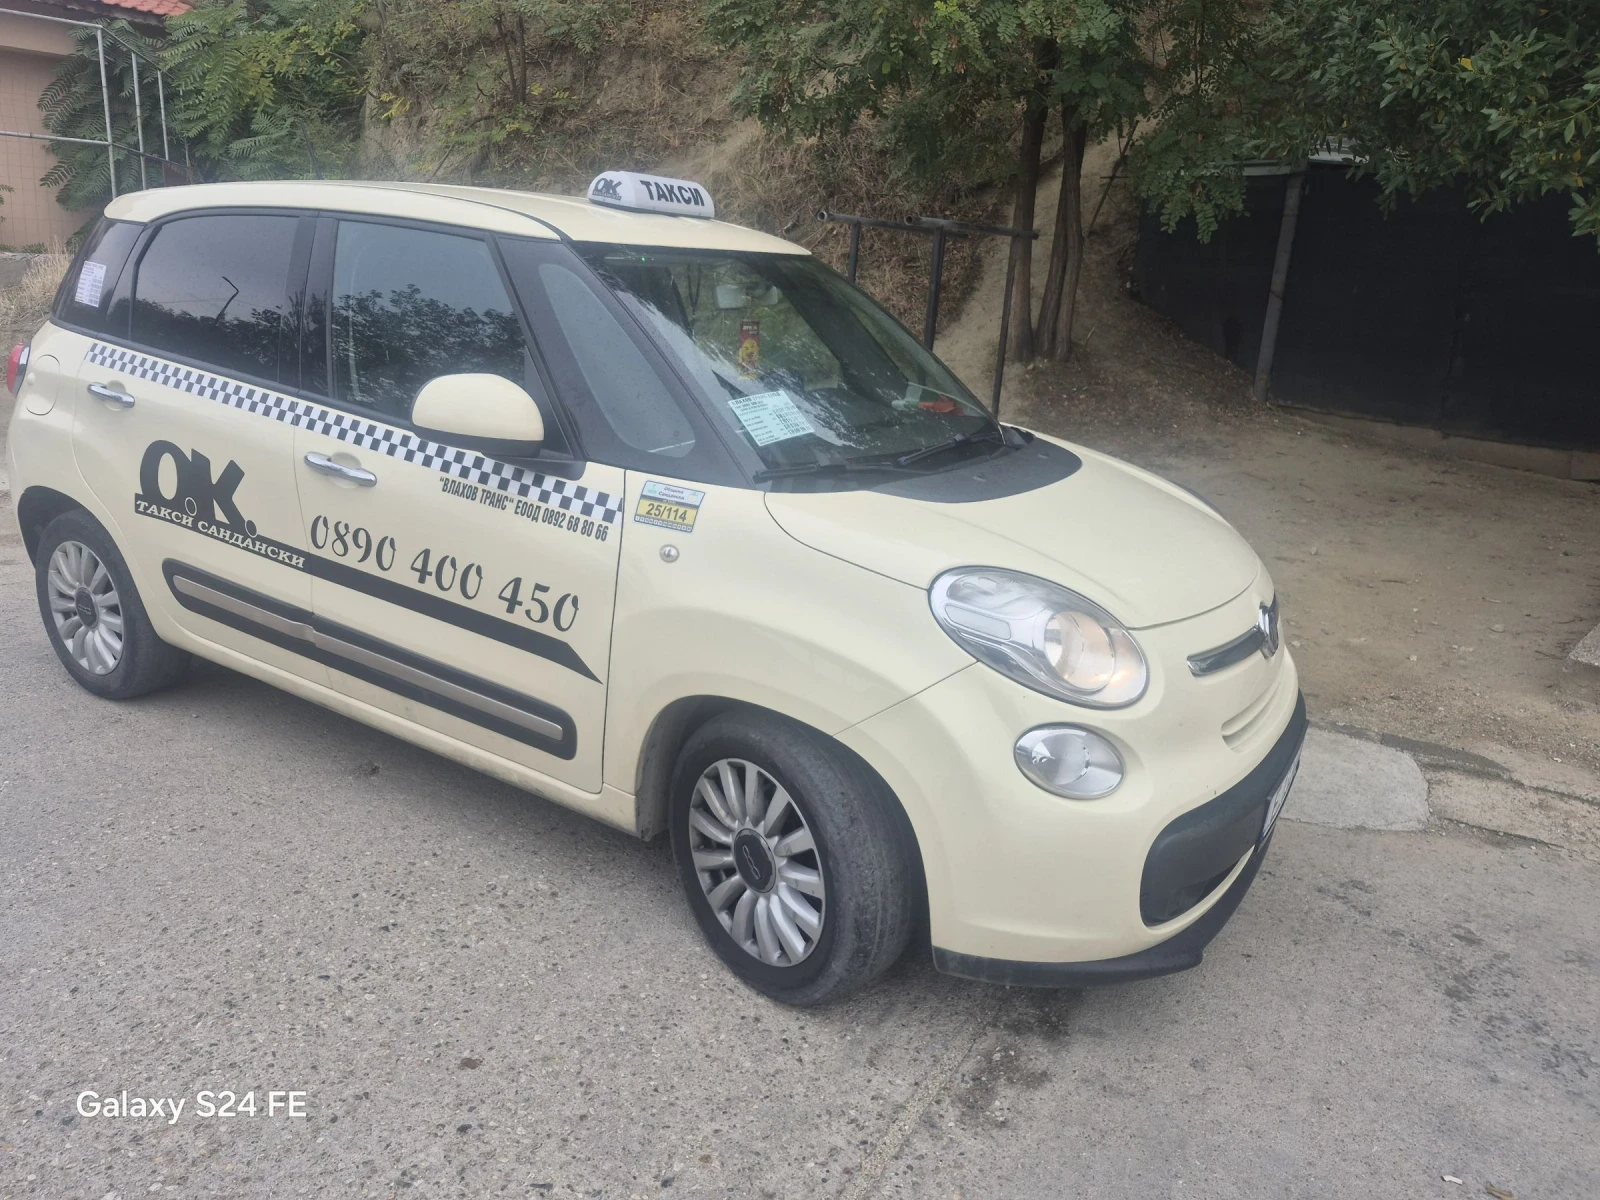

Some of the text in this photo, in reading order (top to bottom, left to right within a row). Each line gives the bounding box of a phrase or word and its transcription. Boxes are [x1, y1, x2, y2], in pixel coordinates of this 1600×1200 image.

[640, 179, 705, 207] ТАКСИ
[514, 499, 542, 523] ЕООД
[541, 507, 567, 529] 0892
[566, 514, 581, 533] 68
[580, 519, 595, 538] 80
[594, 523, 609, 542] 66
[645, 502, 688, 522] 25/114
[136, 499, 306, 569] ТАКСИ САНДАНСКИ
[310, 514, 580, 632] 0890 400 450
